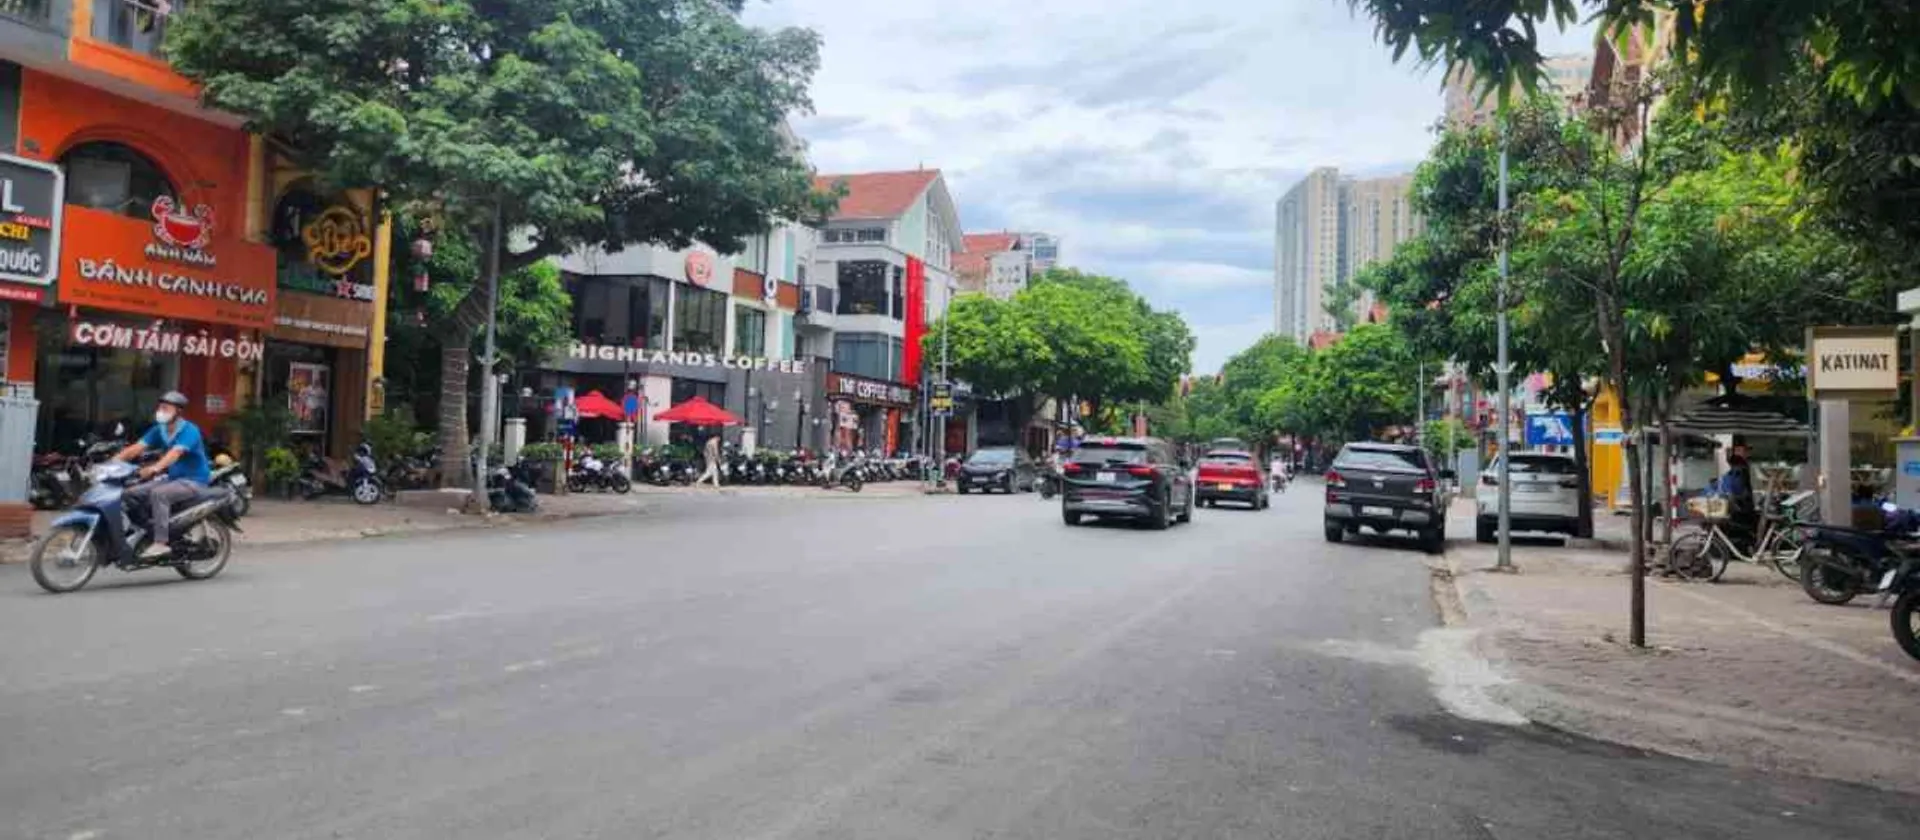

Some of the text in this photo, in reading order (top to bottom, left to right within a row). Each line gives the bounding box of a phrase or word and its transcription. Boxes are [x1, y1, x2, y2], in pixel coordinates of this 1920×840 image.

[79, 257, 153, 286] BÁNH
[158, 274, 222, 298] CANH
[75, 321, 133, 349] CƠM
[136, 319, 180, 353] TẤM
[183, 329, 217, 356] SÀI
[568, 344, 805, 374] HIGHLANDS COFFEE
[1821, 353, 1890, 372] KATINAT
